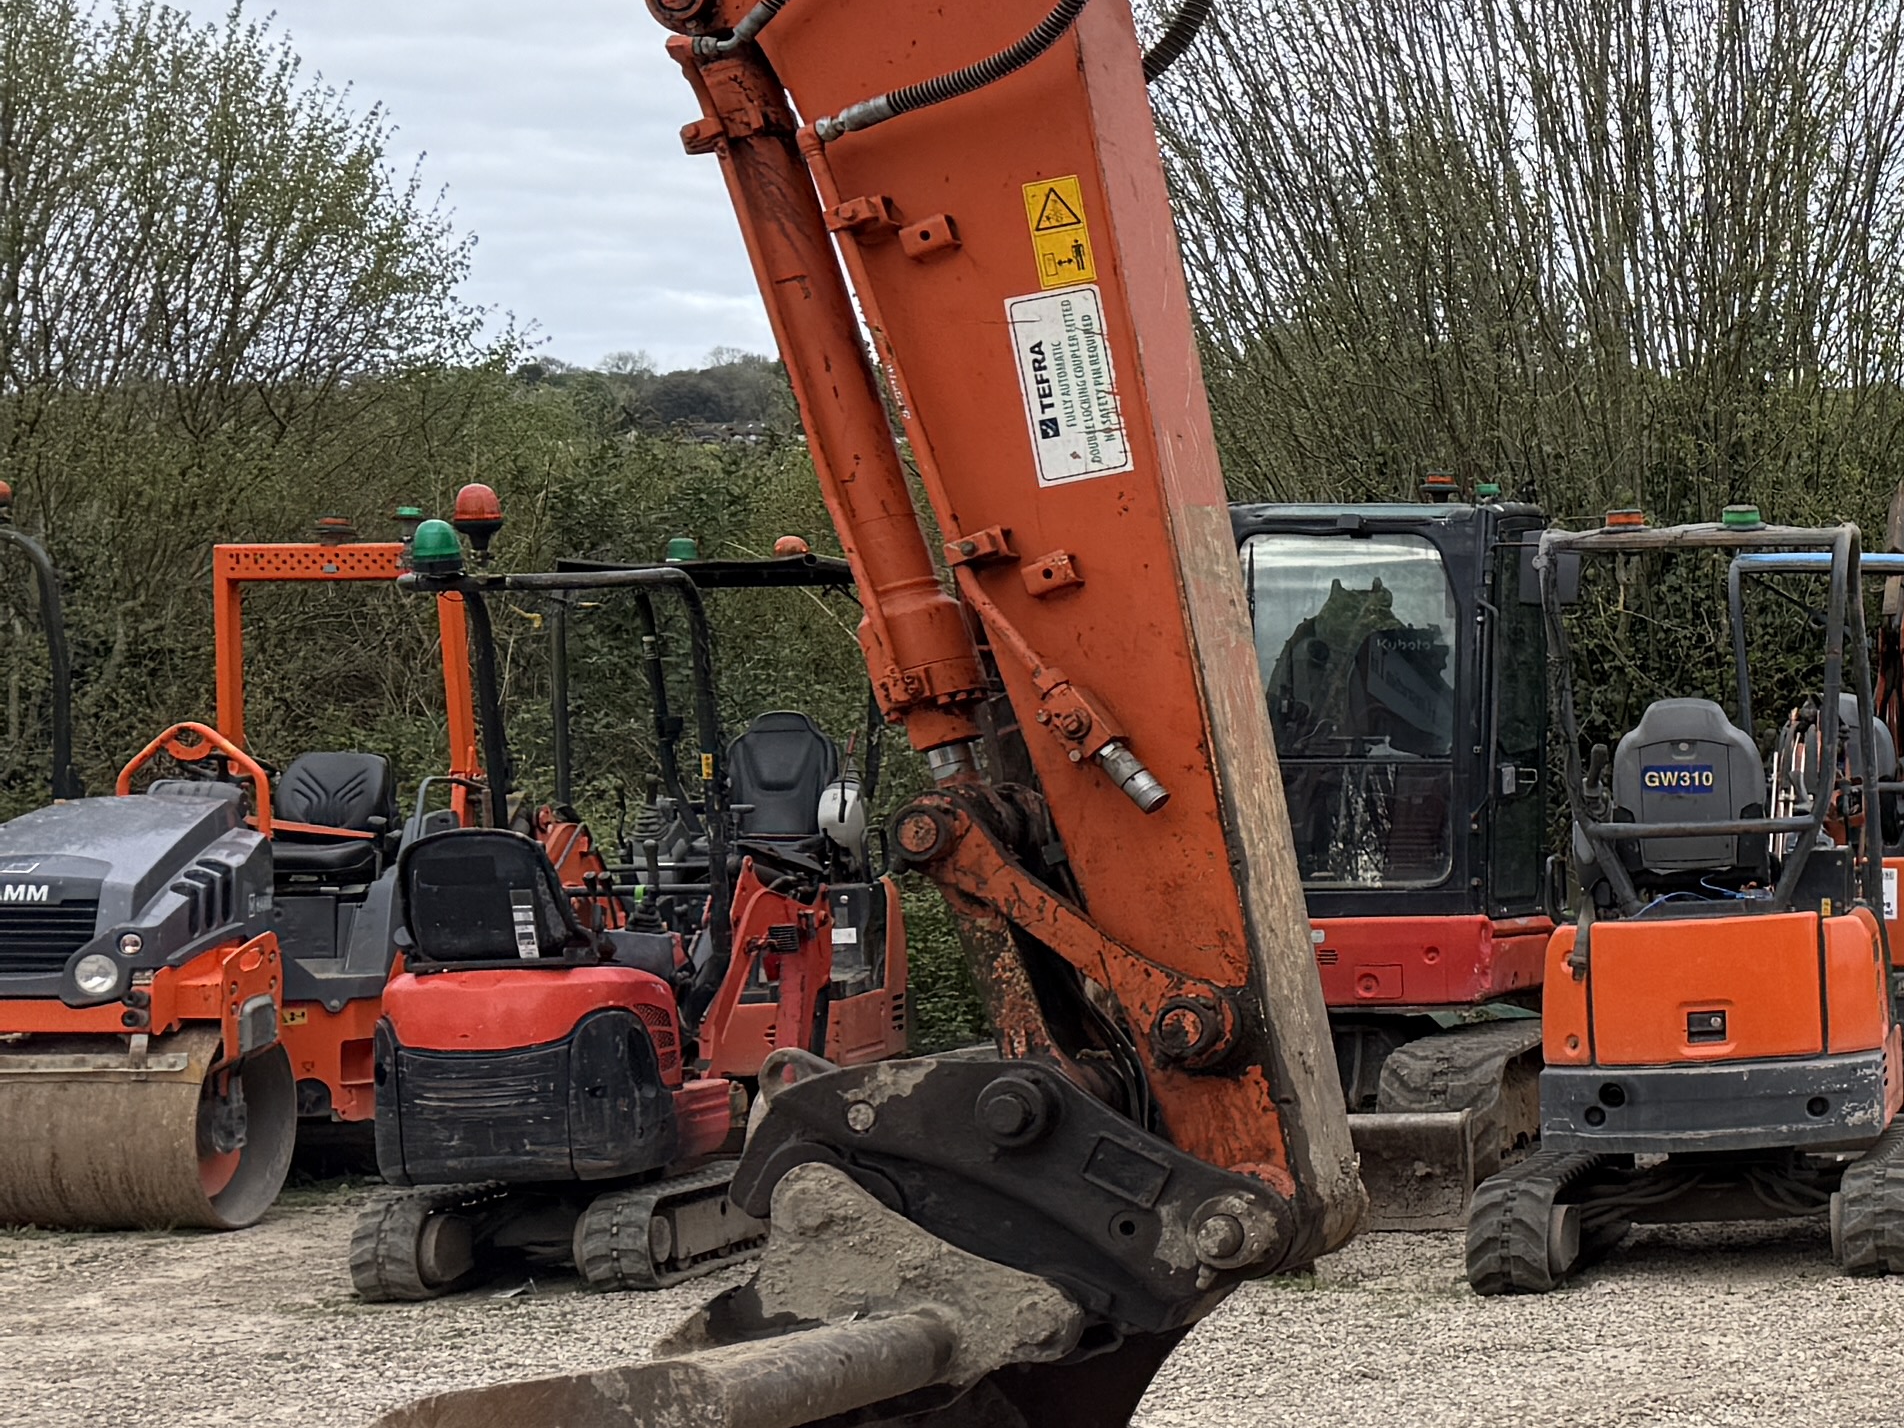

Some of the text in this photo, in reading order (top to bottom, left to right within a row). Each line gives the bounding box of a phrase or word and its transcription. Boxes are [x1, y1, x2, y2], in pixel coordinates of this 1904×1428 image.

[1067, 335, 1084, 379] COUPLER
[1082, 315, 1101, 366] REQUIRED
[1029, 341, 1056, 414] TEFRA
[1052, 341, 1077, 428] FULLY AUTOMATIC
[1093, 368, 1105, 387] PIN
[1076, 380, 1093, 423] LOCKING
[1096, 389, 1112, 427] SAFETY
[1086, 424, 1103, 464] DOUBLE
[1644, 771, 1714, 788] GW310
[0, 884, 49, 902] MM
